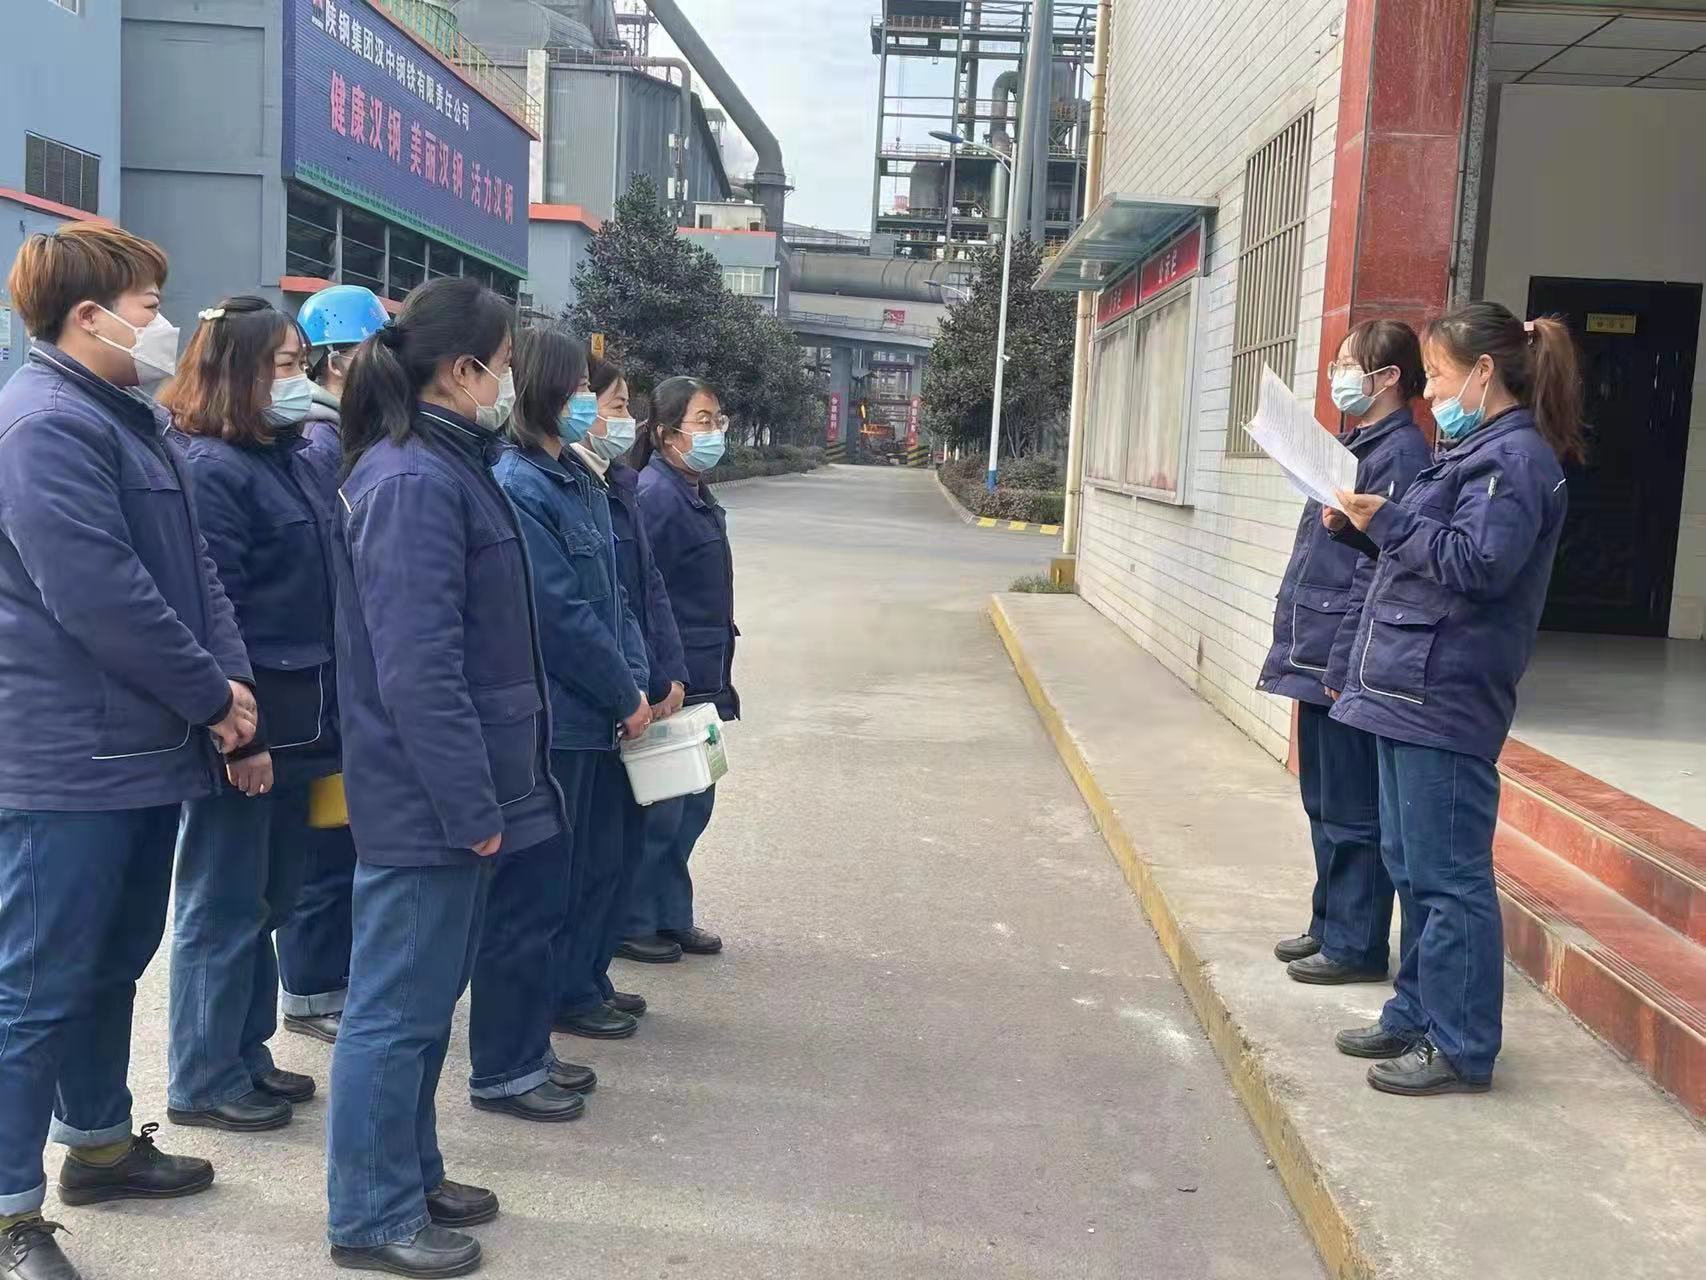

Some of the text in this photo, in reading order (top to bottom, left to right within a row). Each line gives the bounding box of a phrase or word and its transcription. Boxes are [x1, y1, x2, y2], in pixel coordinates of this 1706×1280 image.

[325, 0, 470, 131] 陕钢集团汉中钢铁有限责任公司
[330, 69, 513, 224] 健康汉钢 美丽汉钢 活力汉钢
